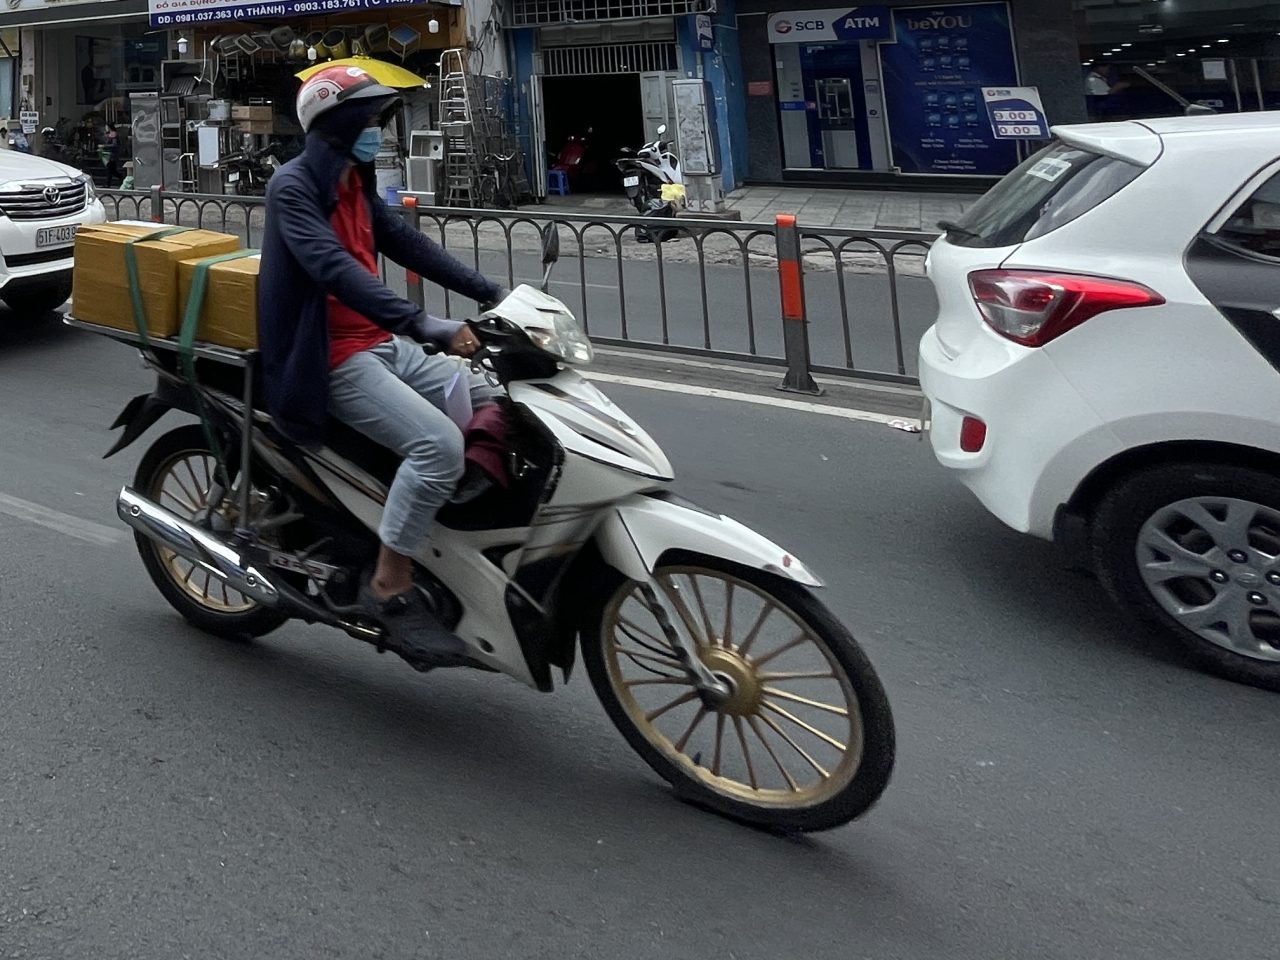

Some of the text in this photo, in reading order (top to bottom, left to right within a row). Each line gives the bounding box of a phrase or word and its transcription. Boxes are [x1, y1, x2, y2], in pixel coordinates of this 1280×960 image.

[175, 10, 232, 22] 0981.037.363
[234, 8, 244, 19] (A
[246, 3, 286, 16] THÀNH)
[795, 16, 880, 31] SCB ATM
